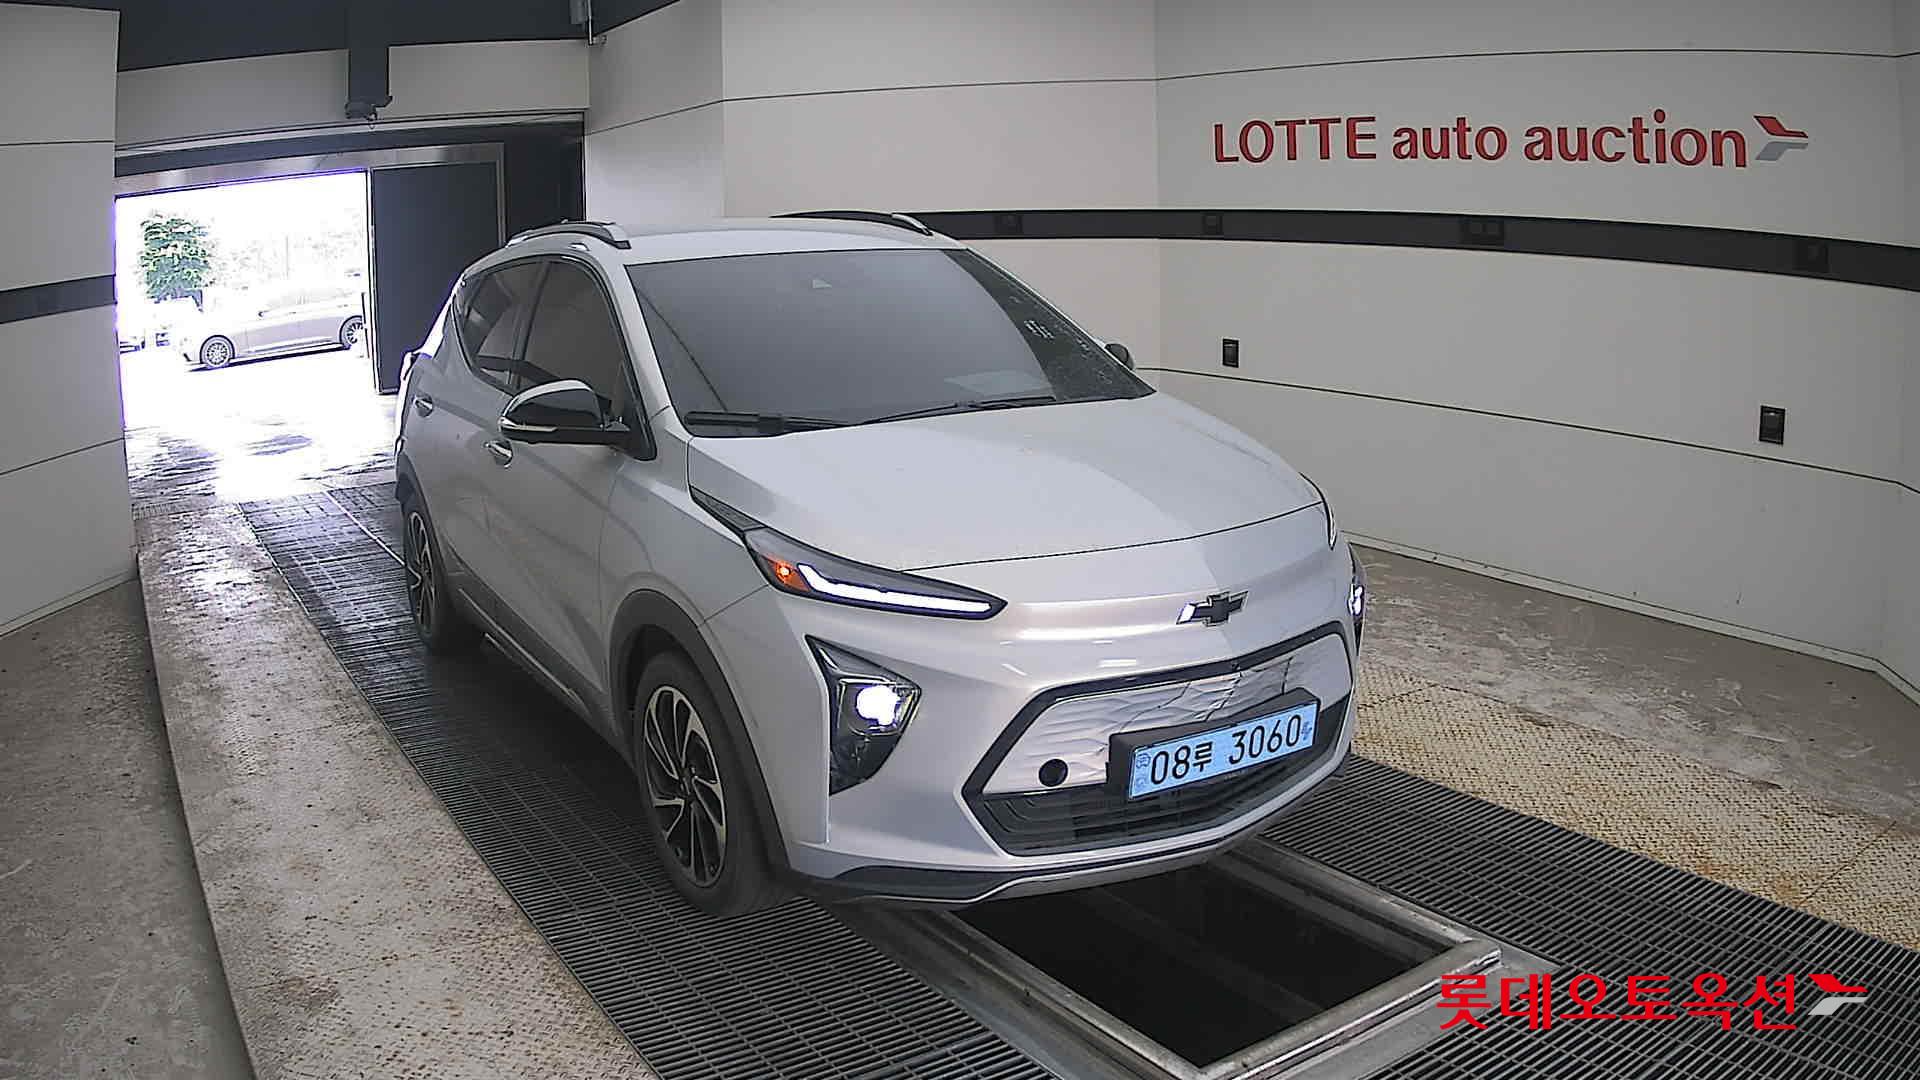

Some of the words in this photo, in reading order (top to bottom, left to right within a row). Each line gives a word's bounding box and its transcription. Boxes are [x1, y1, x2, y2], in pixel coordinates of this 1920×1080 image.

[1213, 116, 1377, 164] LOTTE
[1391, 116, 1508, 162] auto
[1523, 108, 1748, 169] auction
[1150, 741, 1214, 786] 08루
[1228, 713, 1302, 765] 3060
